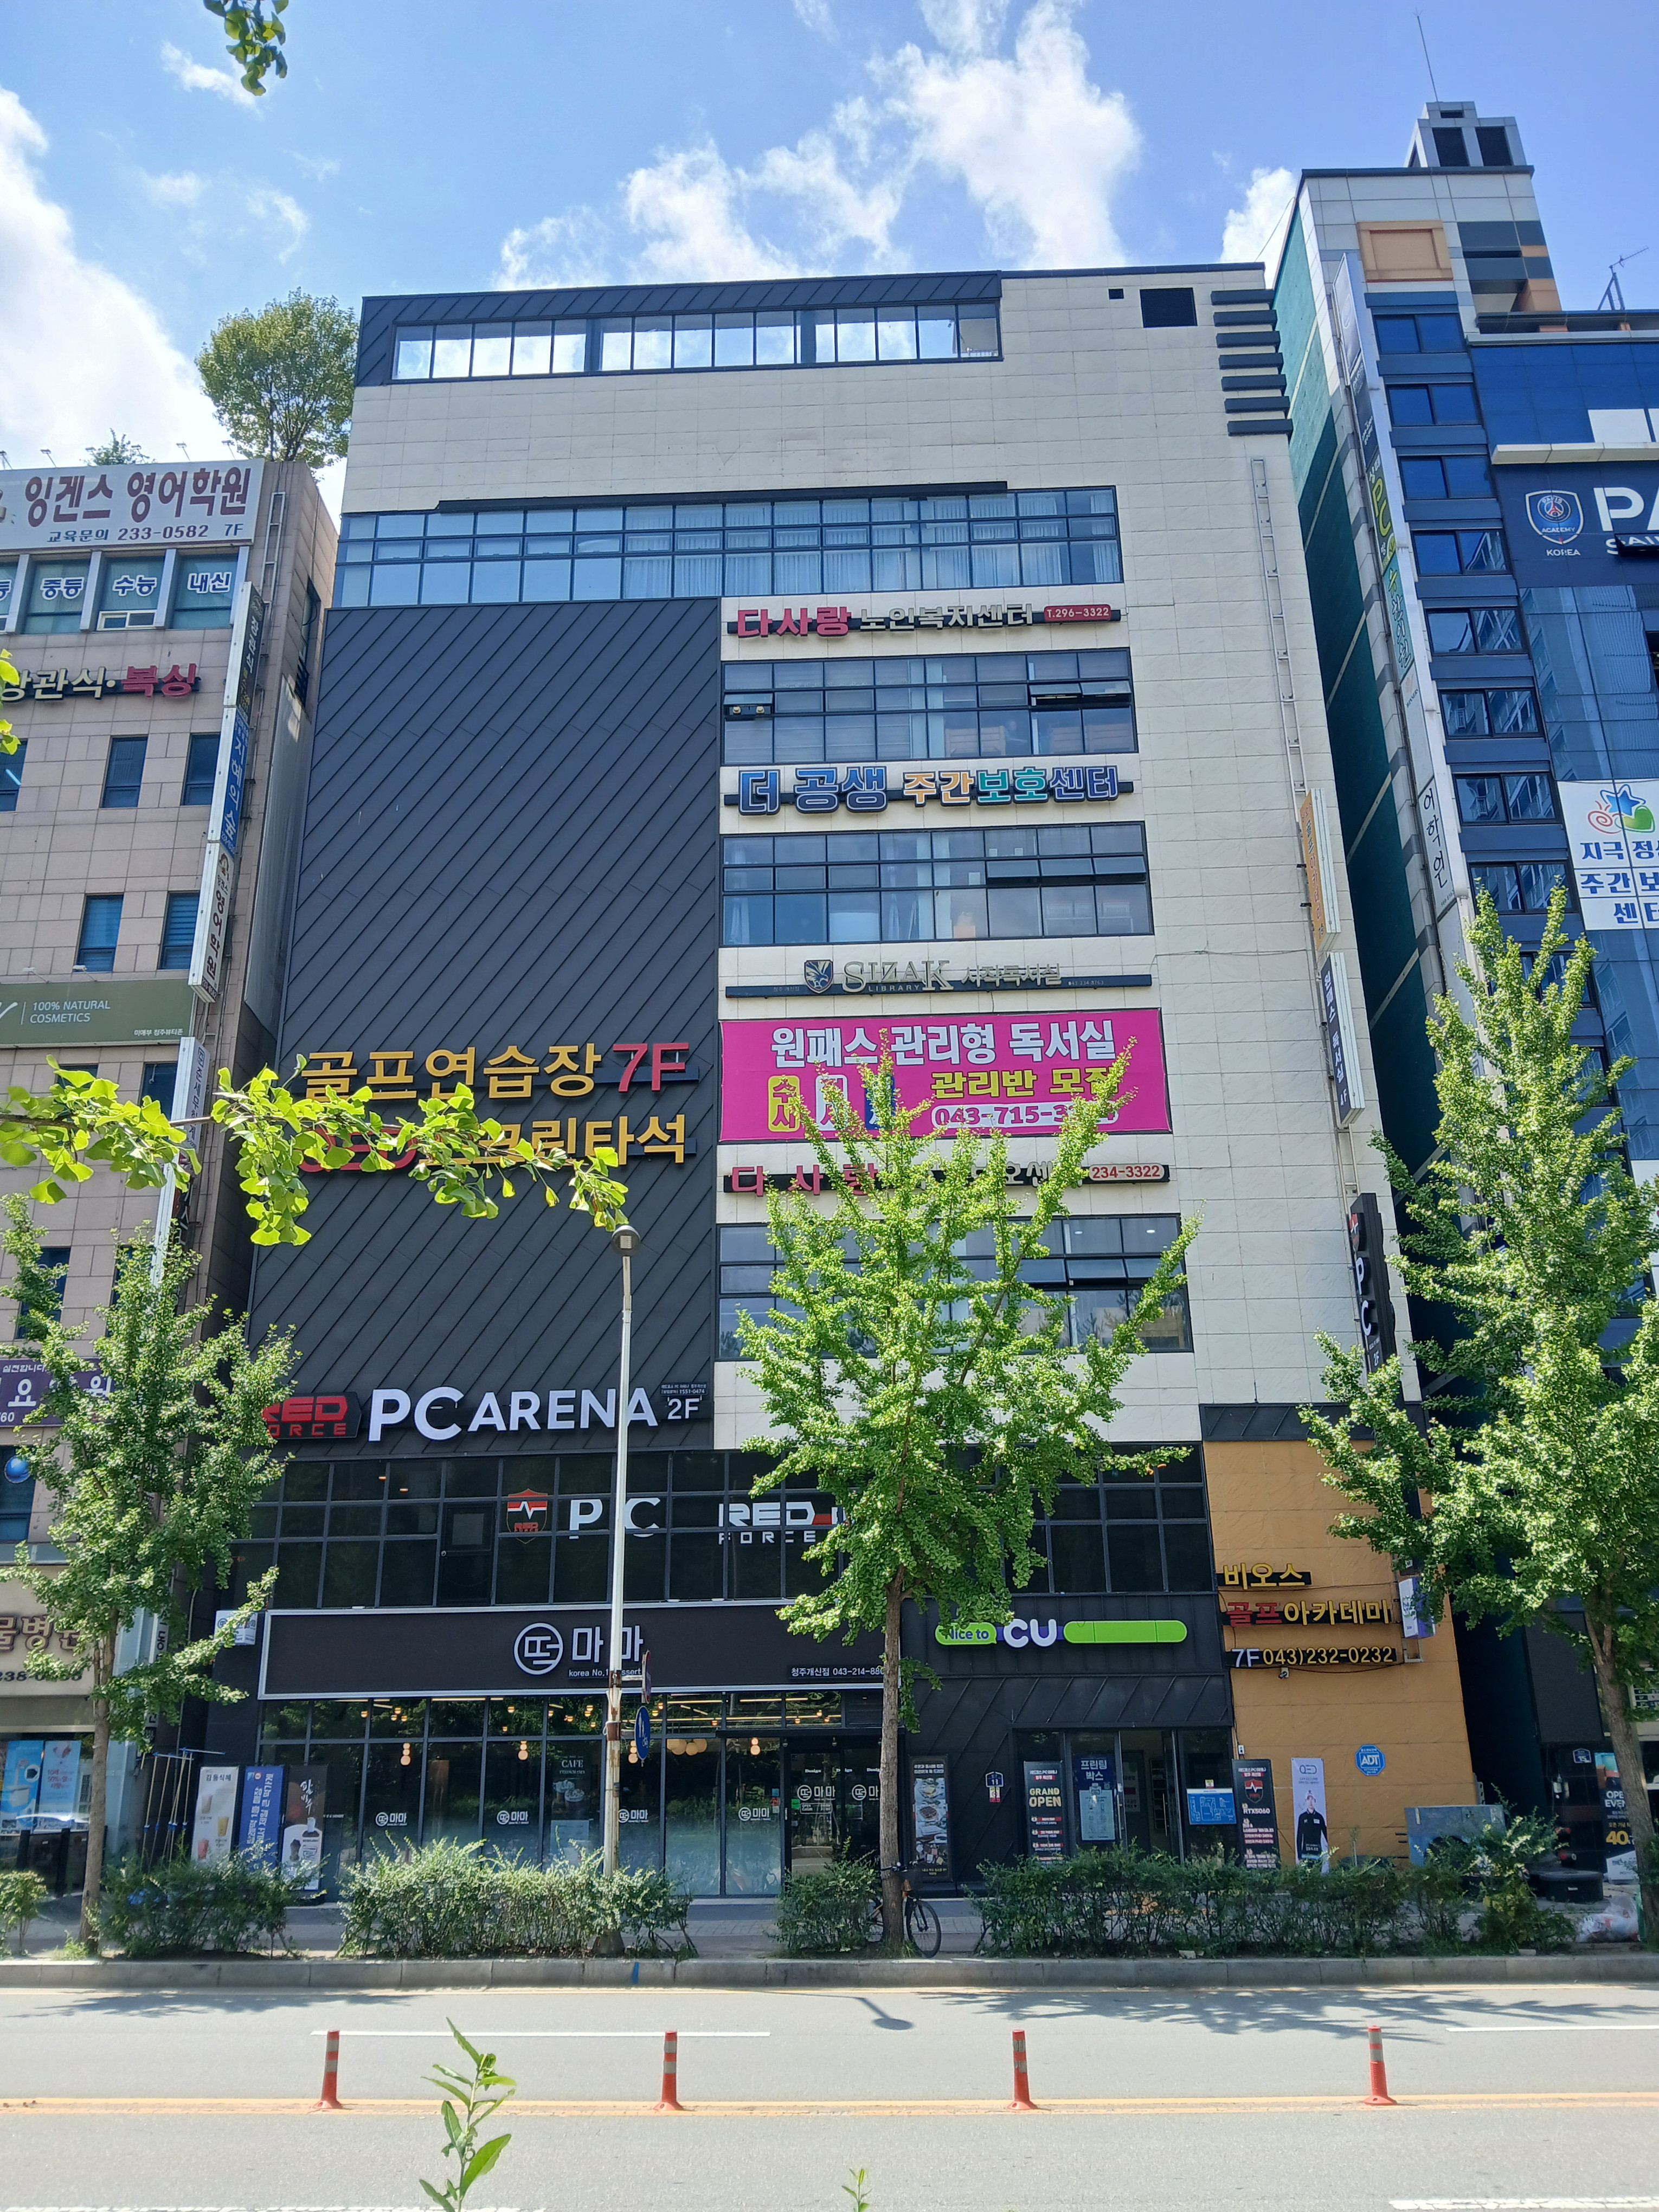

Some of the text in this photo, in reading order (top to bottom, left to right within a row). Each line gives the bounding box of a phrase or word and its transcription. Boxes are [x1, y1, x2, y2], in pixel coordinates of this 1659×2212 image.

[127, 467, 251, 523] 영어학원
[47, 523, 243, 542] 교육문의 233-0582 7F
[41, 572, 232, 599] 중등 수능 내신
[737, 603, 1110, 638] 다사랑 노인복지센터 T.296-3322
[795, 766, 888, 813] 공생
[903, 766, 1119, 807] 주간보호센터
[1424, 788, 1448, 888] 어학원
[207, 890, 226, 981] 영어학원
[842, 960, 954, 993] SIZAK
[962, 963, 1062, 988] 시작독서실
[869, 984, 920, 993] LIBRARY
[33, 1000, 111, 1011] 100% NATURAL
[30, 1012, 91, 1024] COSMETICS
[771, 1020, 1116, 1068] 원패스 관리형 독서실
[301, 1042, 689, 1102] 골프연습장 7F
[930, 1069, 1038, 1099] 관리반
[417, 1114, 685, 1166] 크린타석
[1091, 1165, 1161, 1179] 234-3322
[368, 1386, 659, 1442] PC ARENA
[667, 1398, 700, 1420] 2F
[268, 1423, 347, 1437] ORCE
[718, 1501, 815, 1527] RED
[1223, 1562, 1306, 1590] 비오스
[975, 1629, 989, 1640] to
[1004, 1618, 1057, 1648] CU
[1231, 1646, 1393, 1668] 7F 043)232-0232
[569, 1669, 589, 1677] korea
[592, 1669, 609, 1677] No.1
[791, 1667, 884, 1677] 청주개신점 043-214-88
[561, 1759, 584, 1768] CAFE
[1081, 1759, 1108, 1770] 프린팅
[1361, 1754, 1380, 1765] ADT
[1085, 1770, 1104, 1782] 박스
[1029, 1796, 1062, 1808] OPEN
[1030, 1787, 1060, 1796] GRAND
[1606, 1830, 1629, 1845] 40
